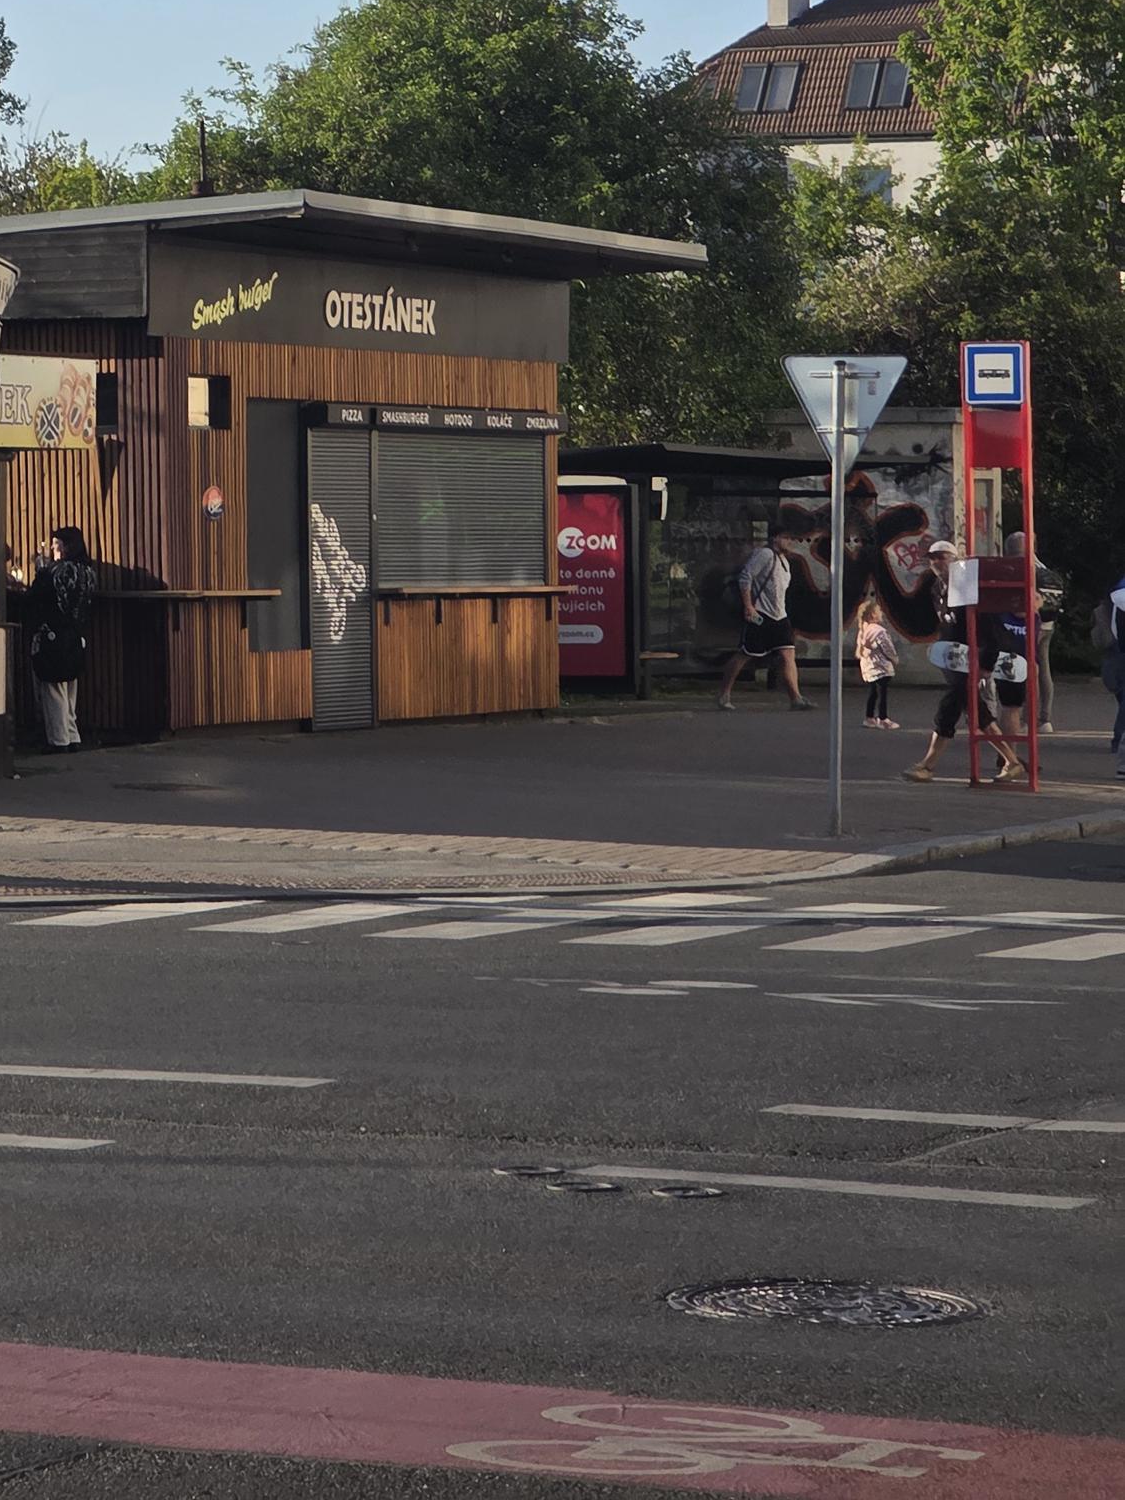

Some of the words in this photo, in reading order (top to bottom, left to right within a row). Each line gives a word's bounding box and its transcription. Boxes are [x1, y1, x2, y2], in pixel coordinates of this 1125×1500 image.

[192, 286, 236, 330] Smash
[238, 271, 278, 312] burger
[325, 285, 436, 336] OTESTÁNEK
[341, 409, 363, 422] PIZZA
[444, 414, 473, 427] HOTDOG
